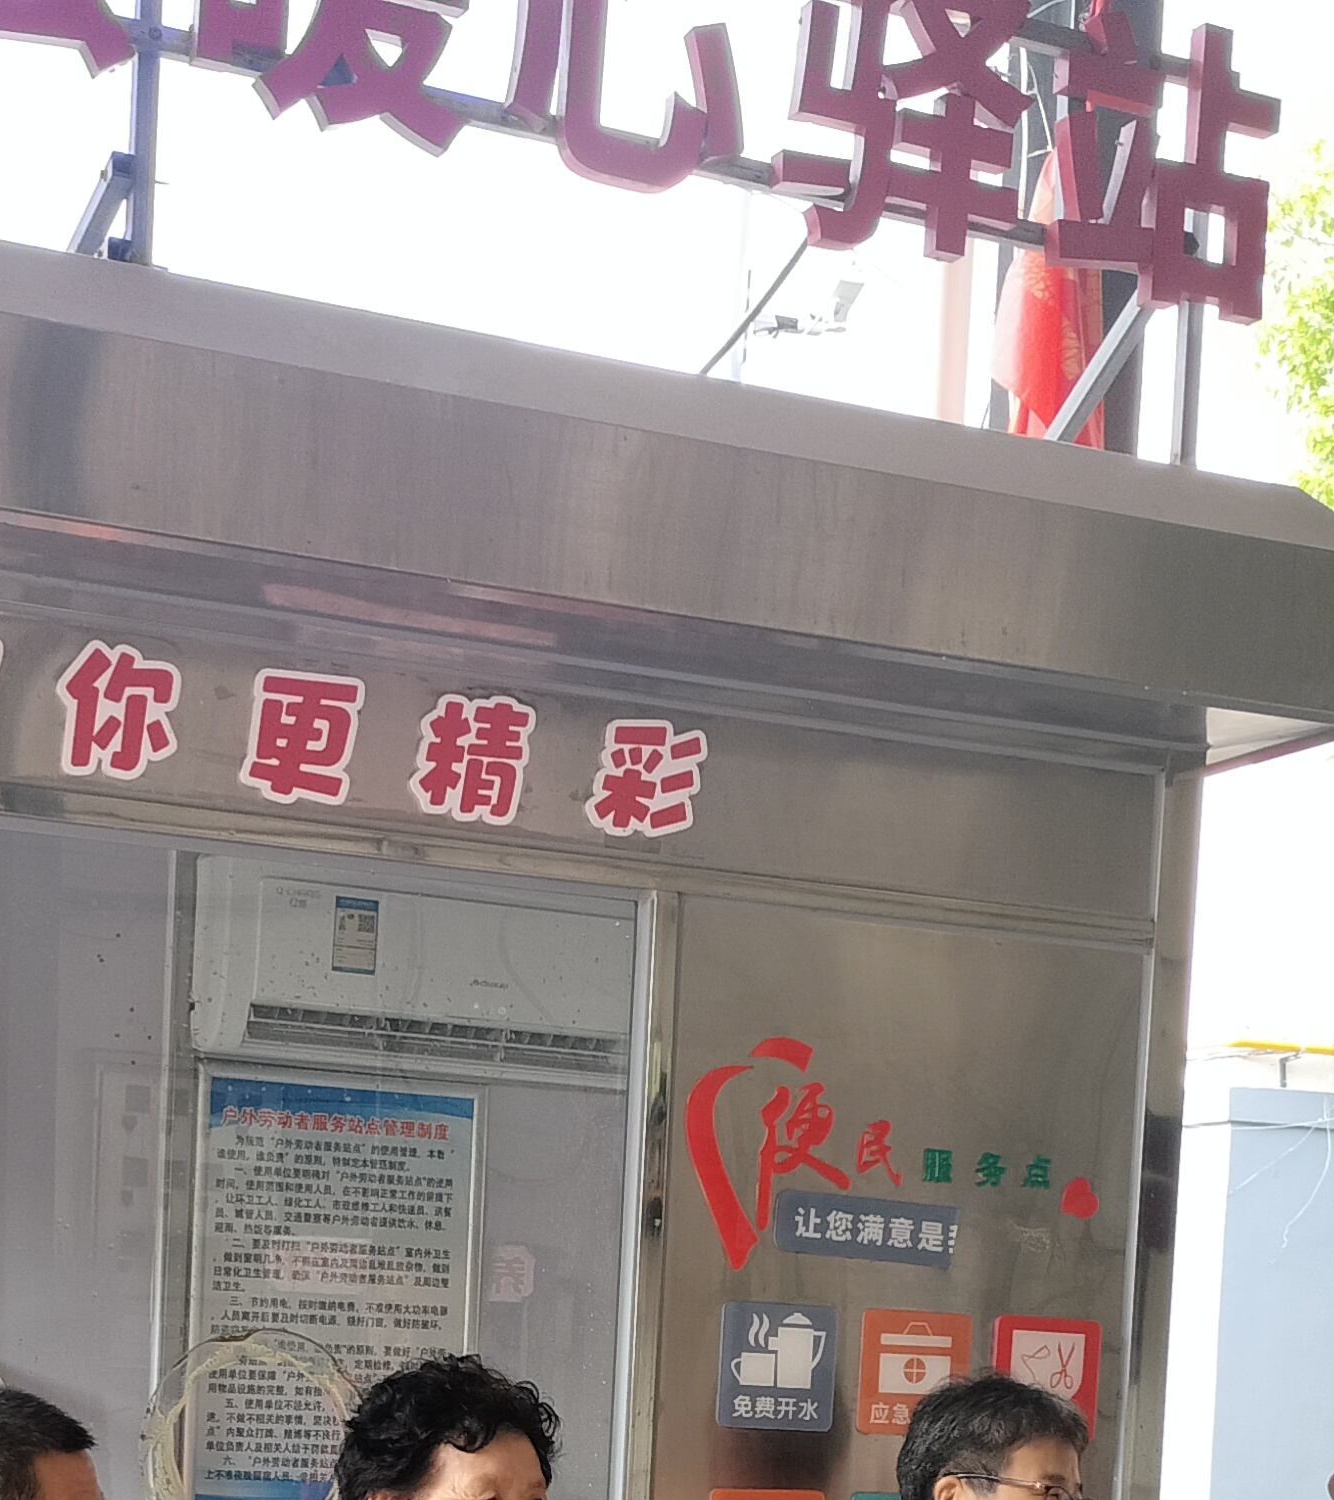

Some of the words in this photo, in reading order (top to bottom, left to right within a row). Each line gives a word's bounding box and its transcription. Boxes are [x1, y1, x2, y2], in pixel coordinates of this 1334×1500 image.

[222, 1106, 450, 1141] 户外劳动者服务站点管理制度
[732, 1396, 819, 1421] 免费开水
